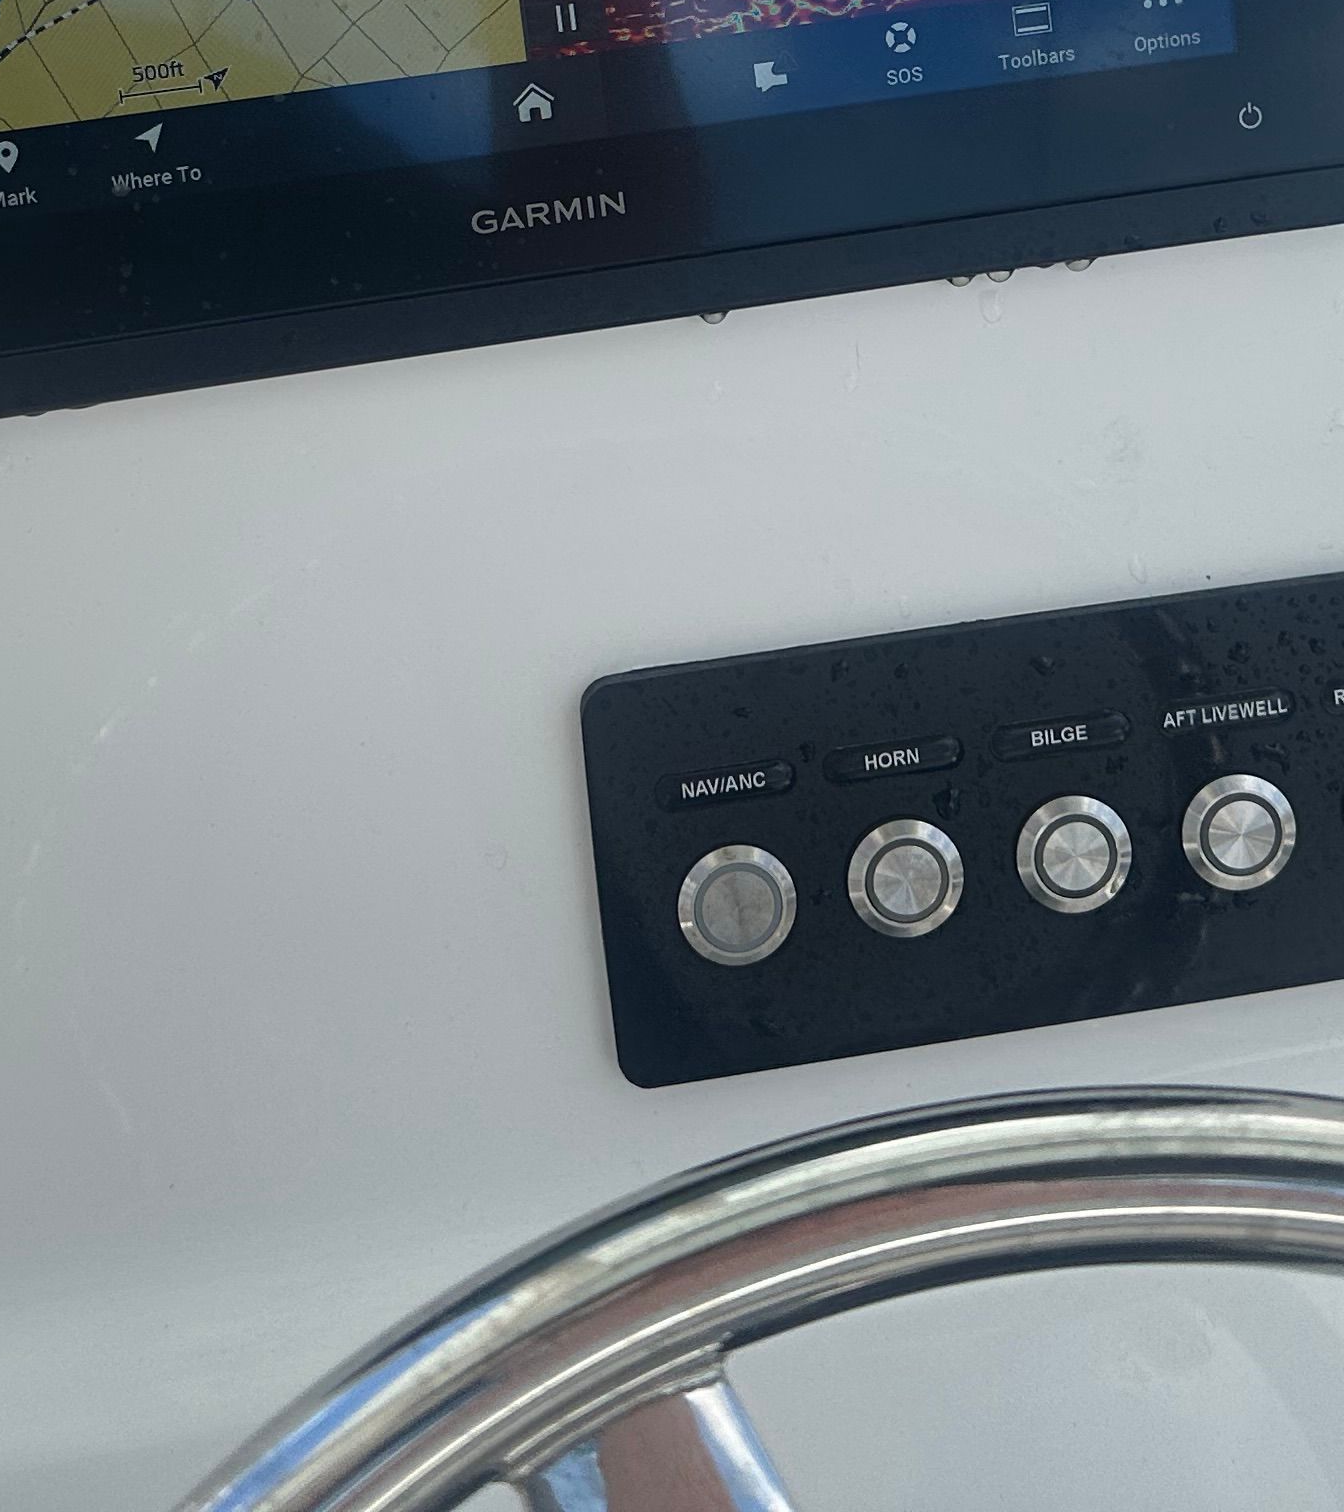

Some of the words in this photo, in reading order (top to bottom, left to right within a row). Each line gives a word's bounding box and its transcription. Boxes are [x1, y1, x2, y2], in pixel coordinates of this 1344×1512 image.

[1134, 31, 1202, 55] Options
[998, 48, 1076, 71] Toolbars
[132, 61, 185, 83] 500ft
[886, 66, 924, 86] SOS
[112, 169, 172, 191] Where
[177, 165, 202, 184] To
[471, 191, 628, 234] GARMIN
[1163, 709, 1197, 729] AFT
[1201, 697, 1288, 726] LIVEWELL
[1030, 724, 1089, 748] BILGE
[864, 748, 921, 771] HORN
[681, 772, 767, 800] NAV/ANC
